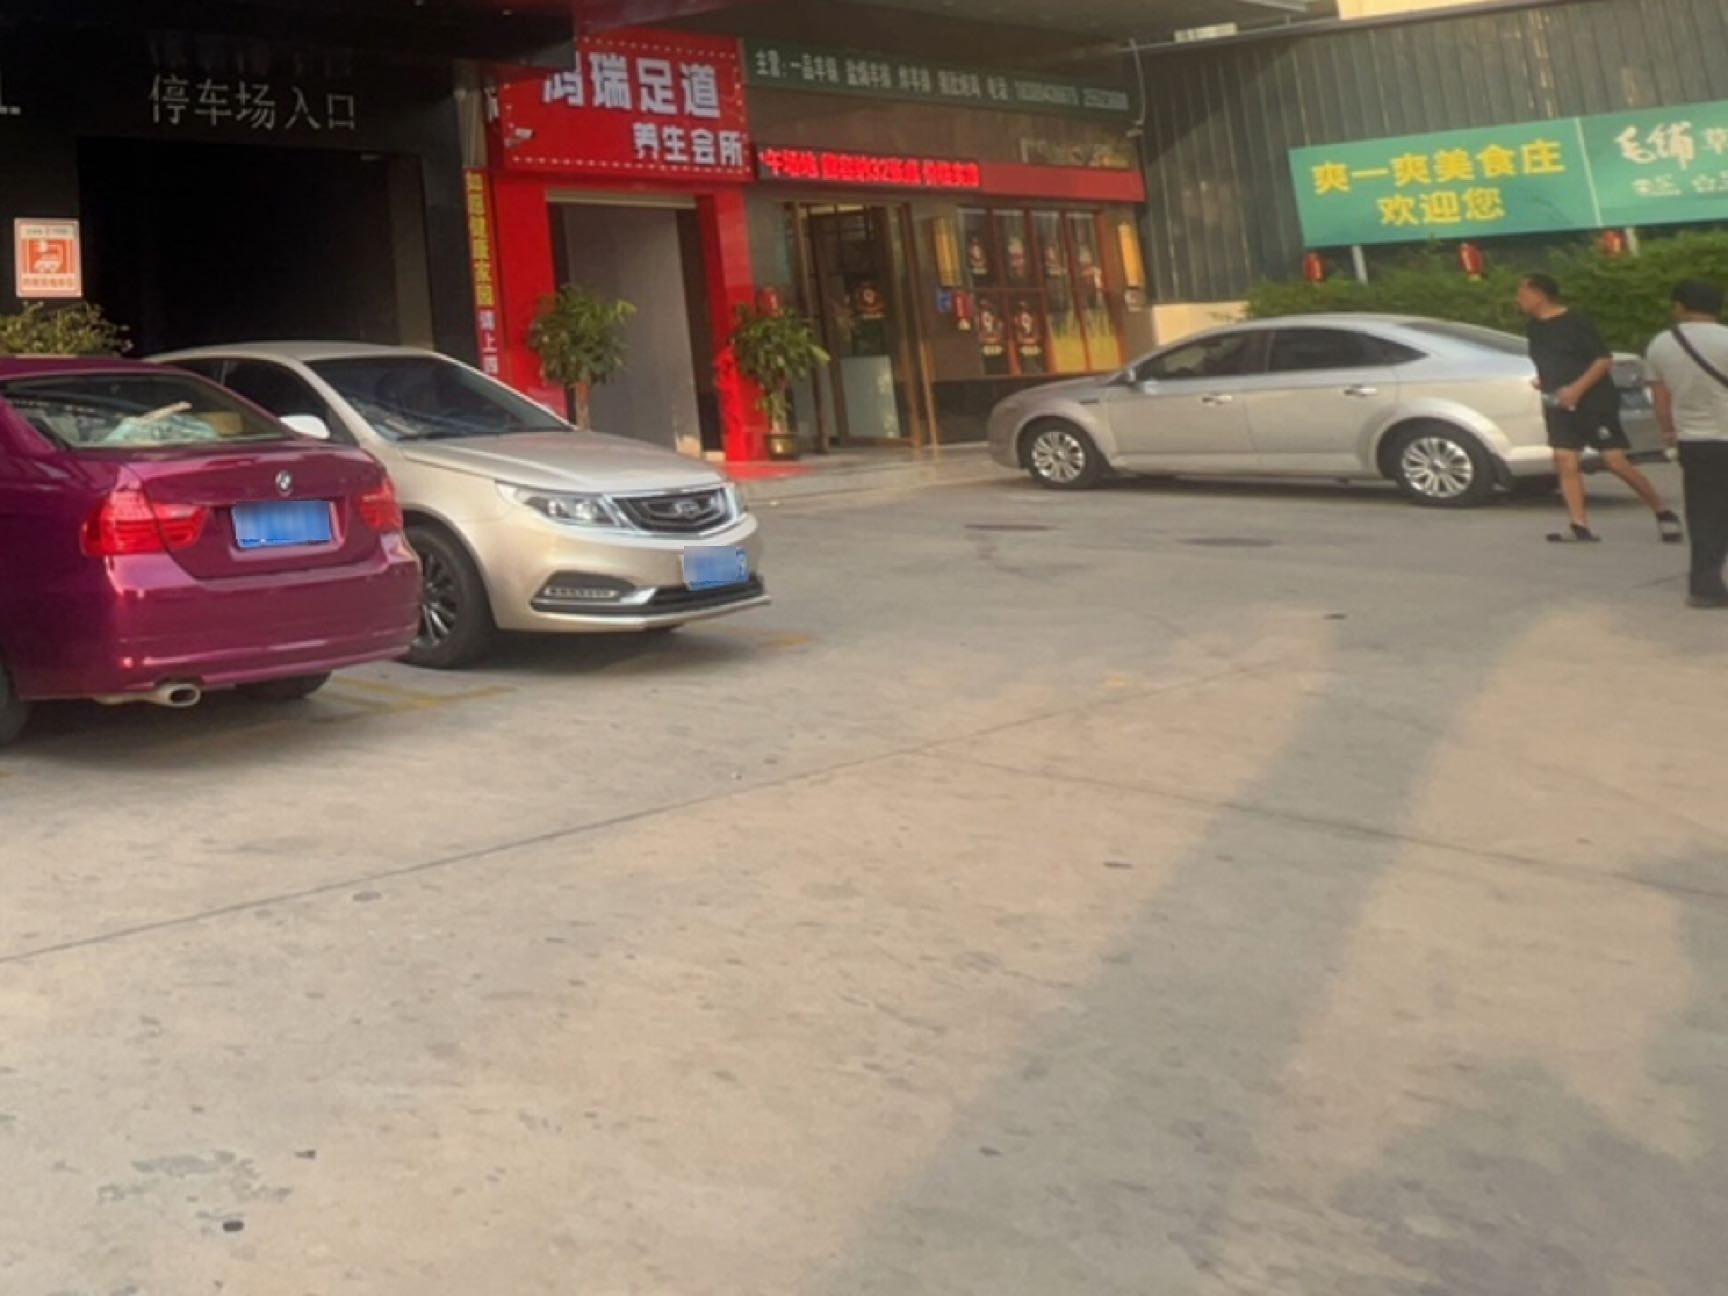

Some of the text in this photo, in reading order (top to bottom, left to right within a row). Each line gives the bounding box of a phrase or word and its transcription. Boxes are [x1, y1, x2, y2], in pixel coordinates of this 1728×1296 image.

[149, 73, 356, 131] 停车场入口
[631, 122, 745, 167] 养生会所
[1310, 137, 1567, 194] 爽一爽美食庄
[1377, 186, 1506, 227] 欢迎您
